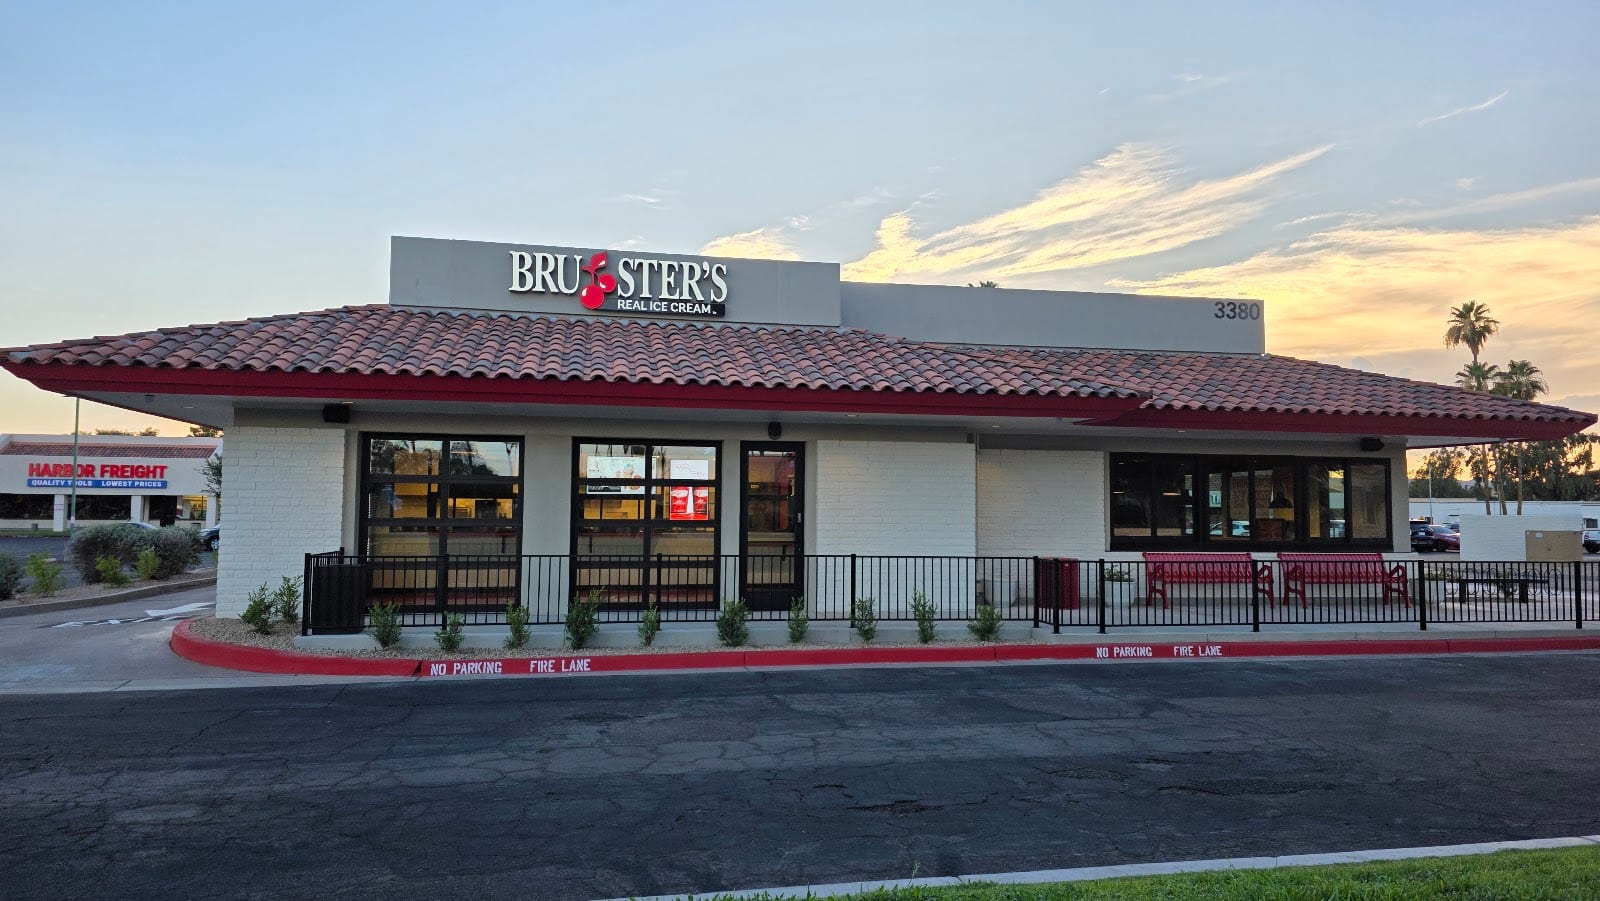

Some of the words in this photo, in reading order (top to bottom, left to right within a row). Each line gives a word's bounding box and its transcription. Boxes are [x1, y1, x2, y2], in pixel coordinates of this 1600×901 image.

[617, 299, 647, 311] REAL
[650, 300, 668, 312] ICE
[1214, 301, 1260, 320] 3380
[100, 464, 168, 479] FREIGHT
[31, 479, 65, 487] QUALITY
[1096, 647, 1108, 658] NO
[1113, 646, 1153, 657] PARKING
[1173, 646, 1194, 657] FIRE
[1198, 645, 1222, 657] LANE
[430, 663, 447, 676] NO
[453, 661, 503, 675] PARKING
[529, 660, 556, 673] FIRE
[561, 658, 591, 672] LANE
